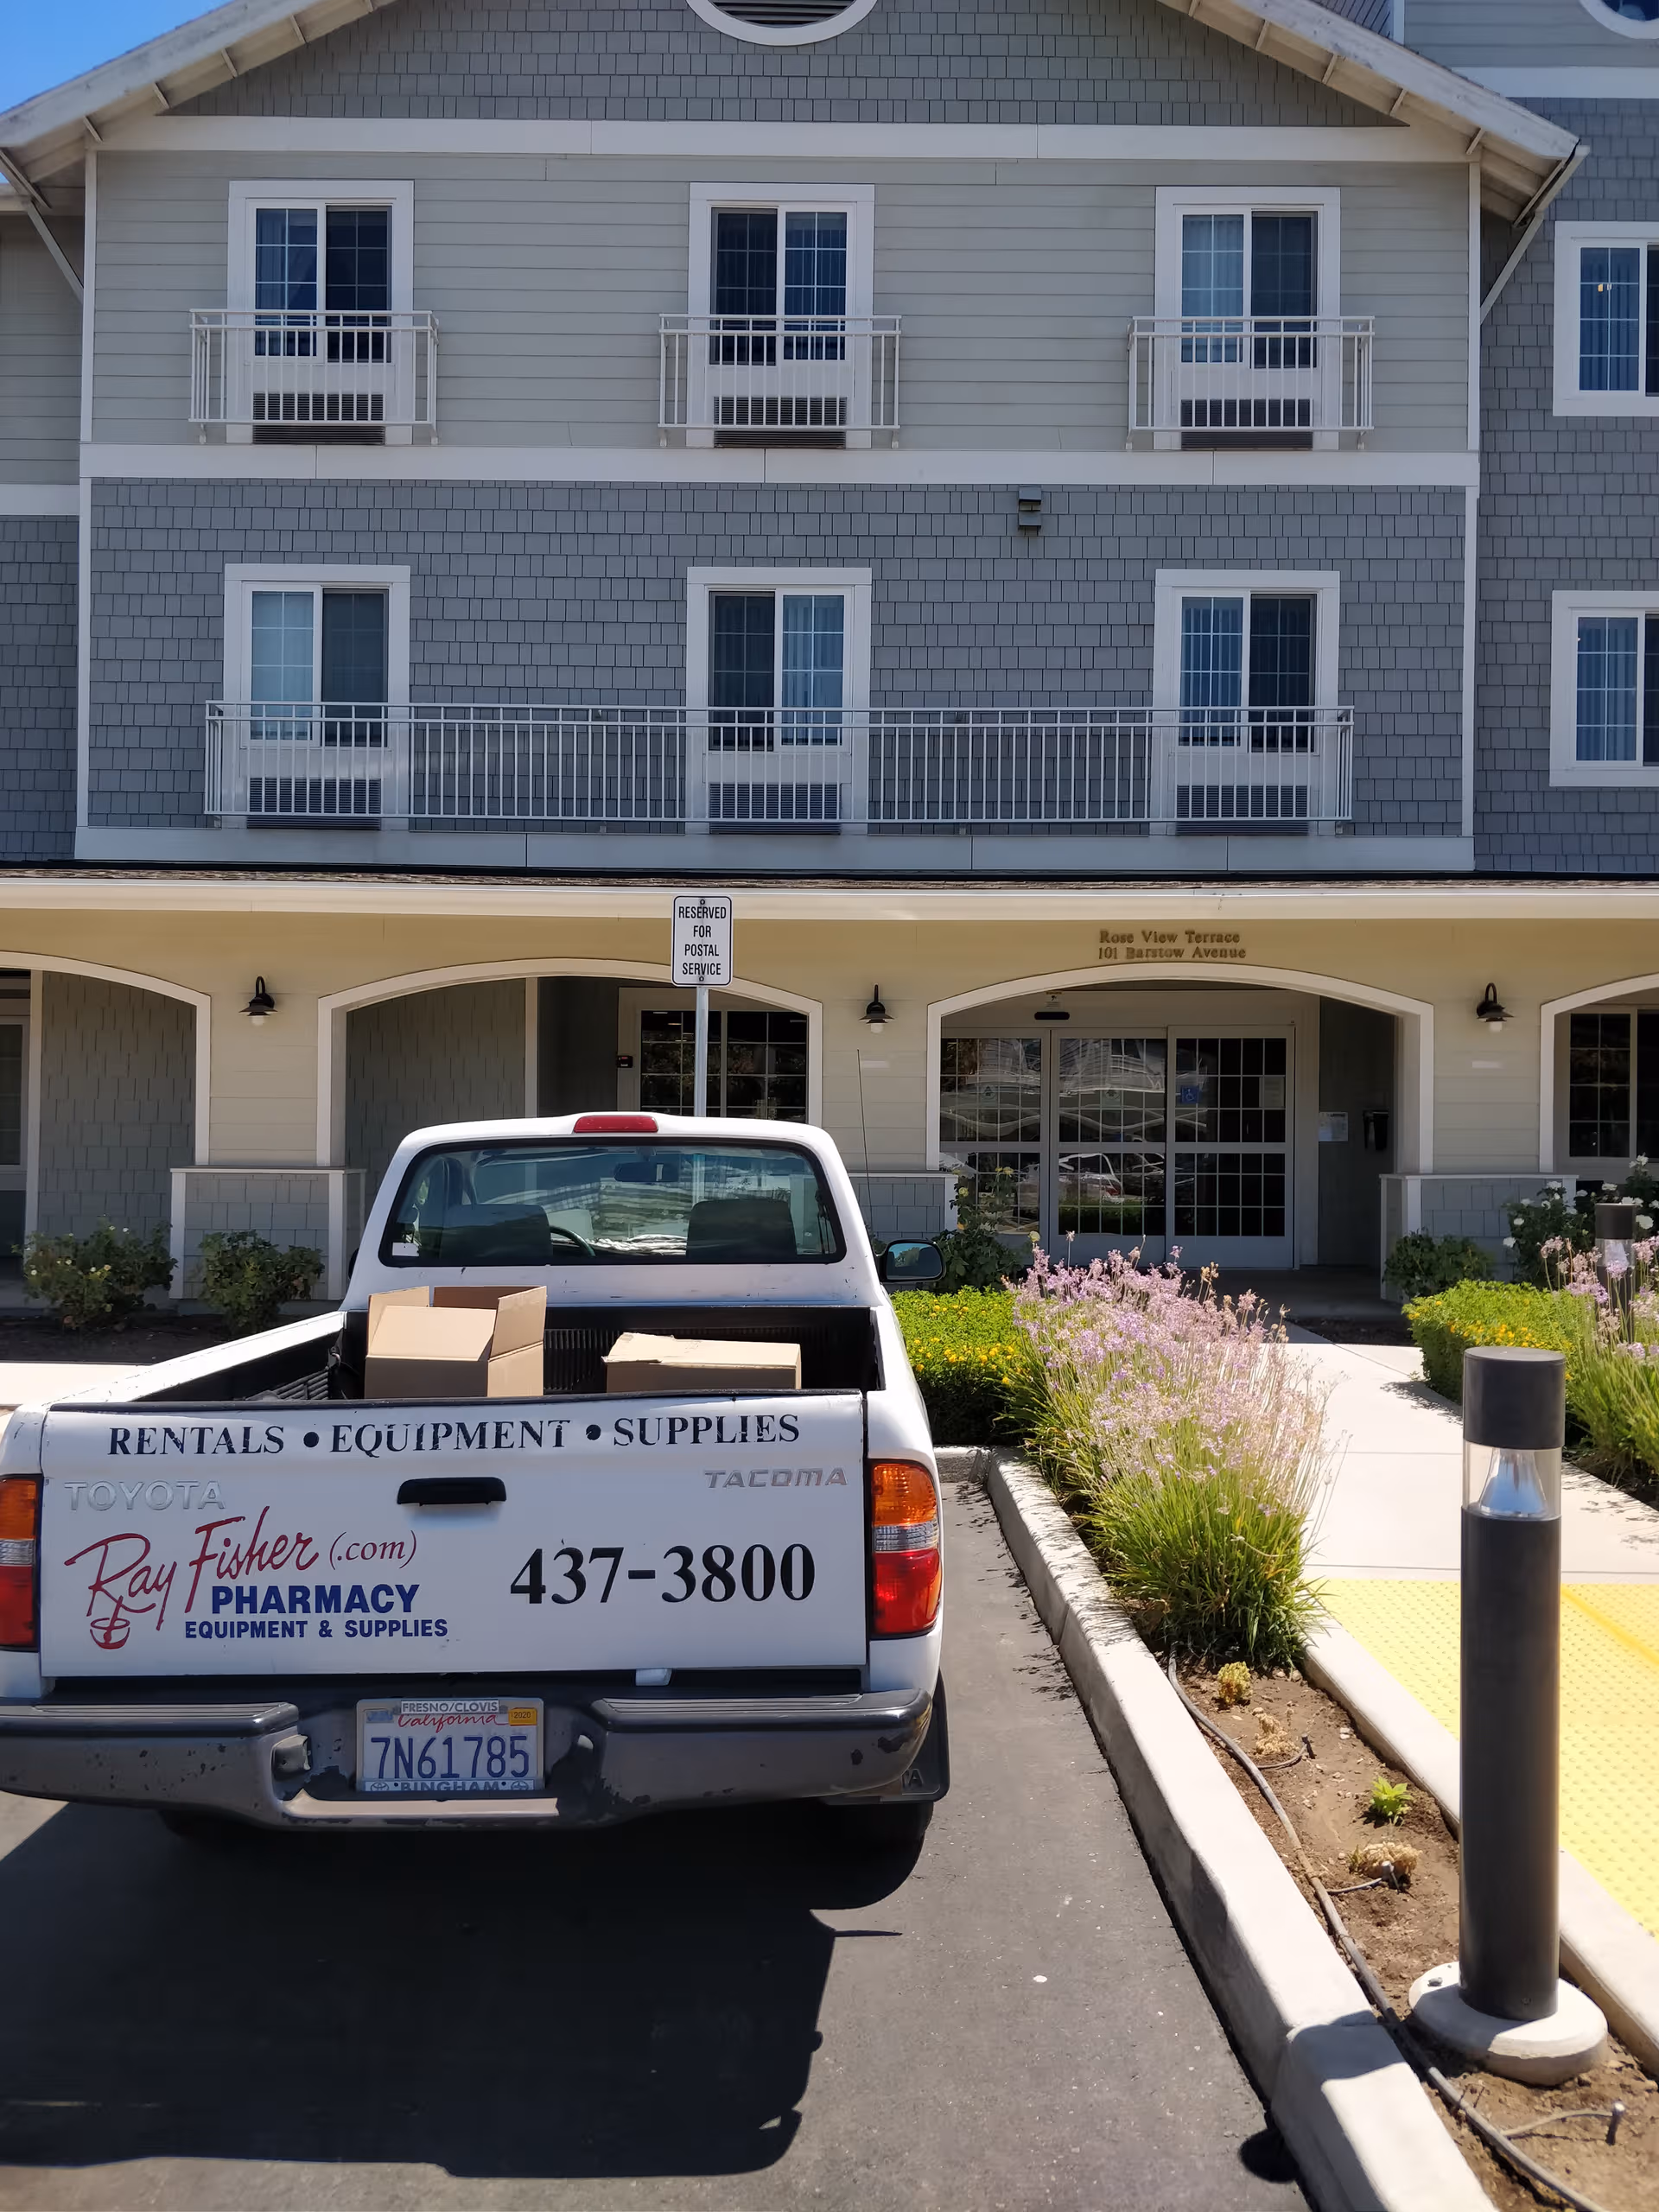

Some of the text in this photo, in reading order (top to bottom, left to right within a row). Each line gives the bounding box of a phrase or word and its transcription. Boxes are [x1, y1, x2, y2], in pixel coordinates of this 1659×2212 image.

[678, 906, 727, 918] RESERVED
[693, 925, 711, 938] FOR
[1099, 930, 1240, 944] Rose View Terrace
[684, 944, 719, 957] POSTAL
[1098, 946, 1246, 960] 101 Barstow Avenue
[682, 963, 721, 976] SERVICE
[107, 1414, 800, 1458] RENTALS EQUIPMENT SUPPLIES
[705, 1466, 848, 1489] TACOMA
[64, 1480, 226, 1511] TOYOTA
[64, 1506, 417, 1631] Ray Fisher (.com)
[510, 1543, 815, 1605] 437-3800
[212, 1584, 419, 1614] PHARMACY
[185, 1619, 448, 1639] EQUIPMENT & SUPPLIES
[402, 1702, 498, 1713] FRESNO/CLOVIS
[397, 1713, 508, 1733] California
[371, 1735, 530, 1779] 7N61785
